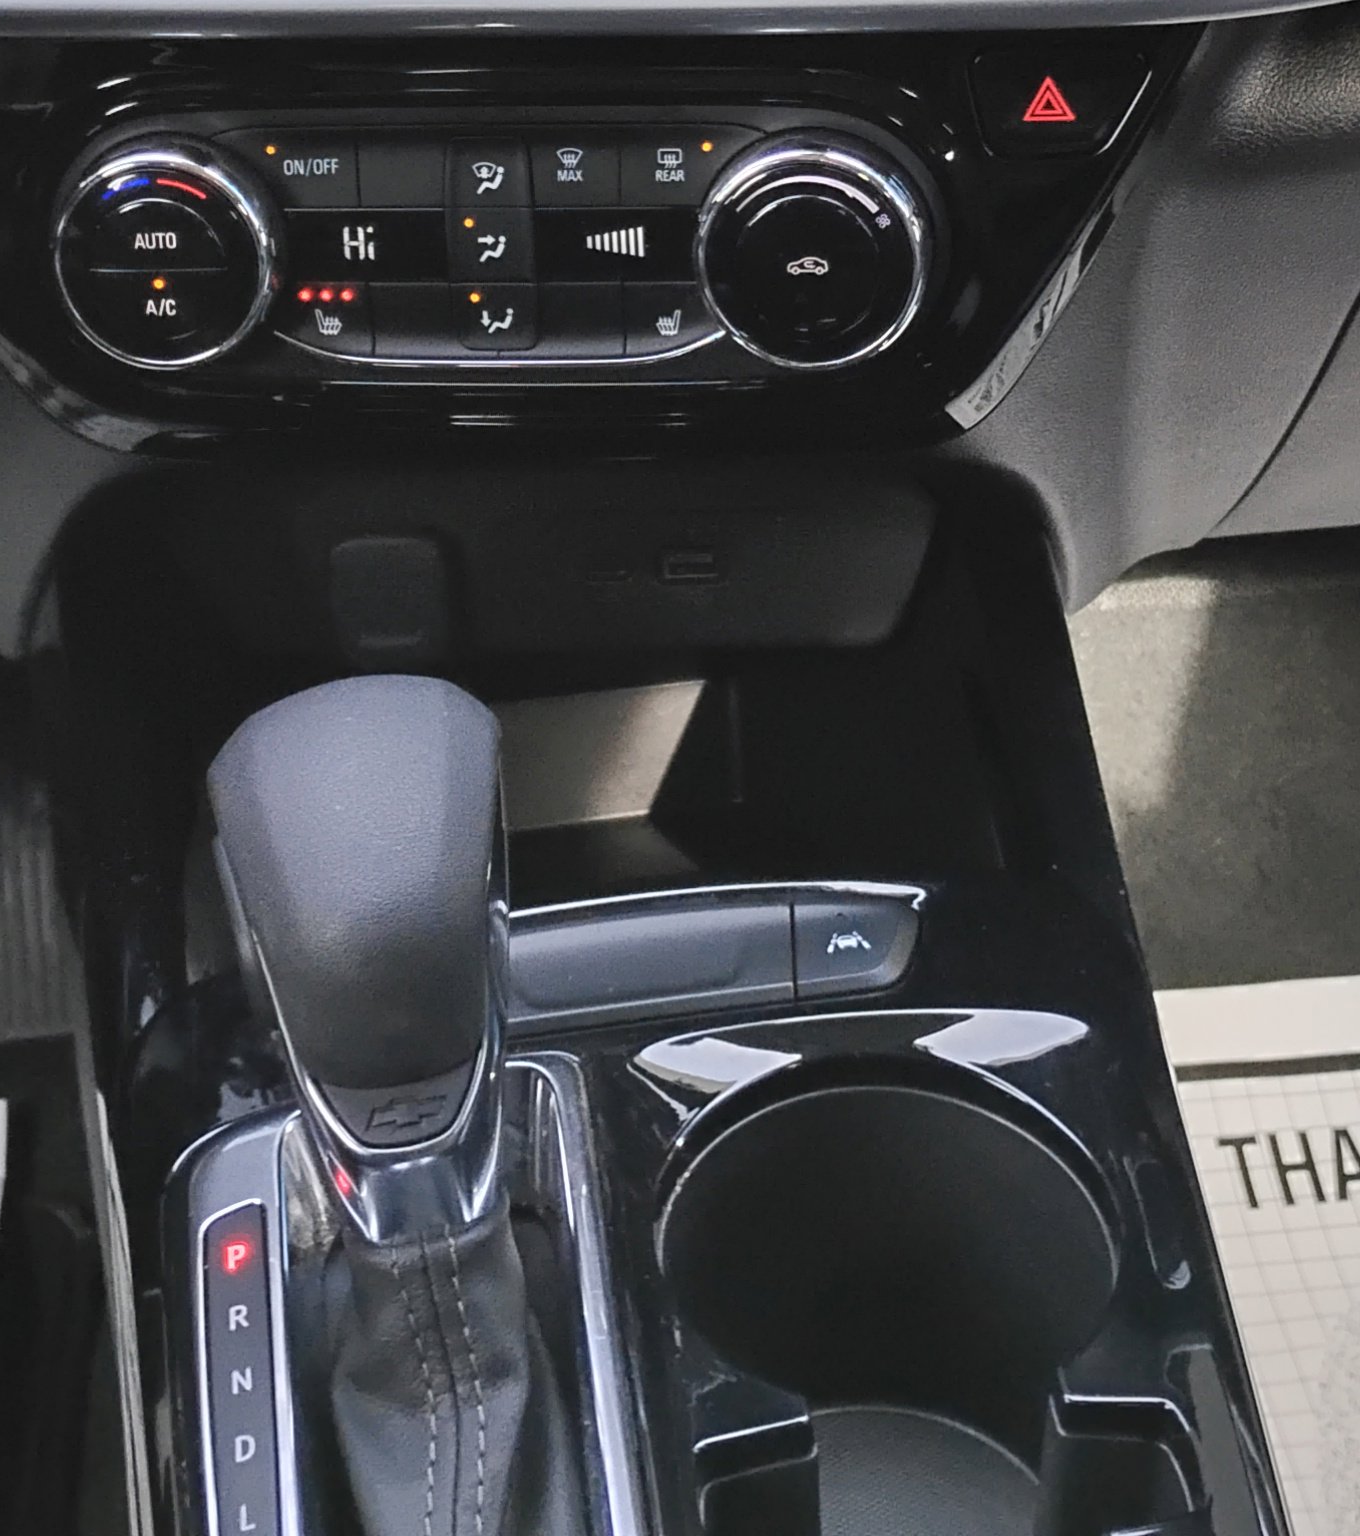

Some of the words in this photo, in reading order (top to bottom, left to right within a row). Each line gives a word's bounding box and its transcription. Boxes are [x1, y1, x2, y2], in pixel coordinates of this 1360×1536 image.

[283, 158, 339, 177] ON/OFF
[557, 170, 583, 182] MAX
[655, 170, 685, 182] REAR
[134, 232, 177, 251] AUTO
[145, 298, 177, 317] A/C
[226, 1244, 248, 1271] P
[228, 1304, 249, 1331] R
[230, 1367, 254, 1395] N
[235, 1434, 256, 1463] D
[240, 1503, 256, 1532] L
